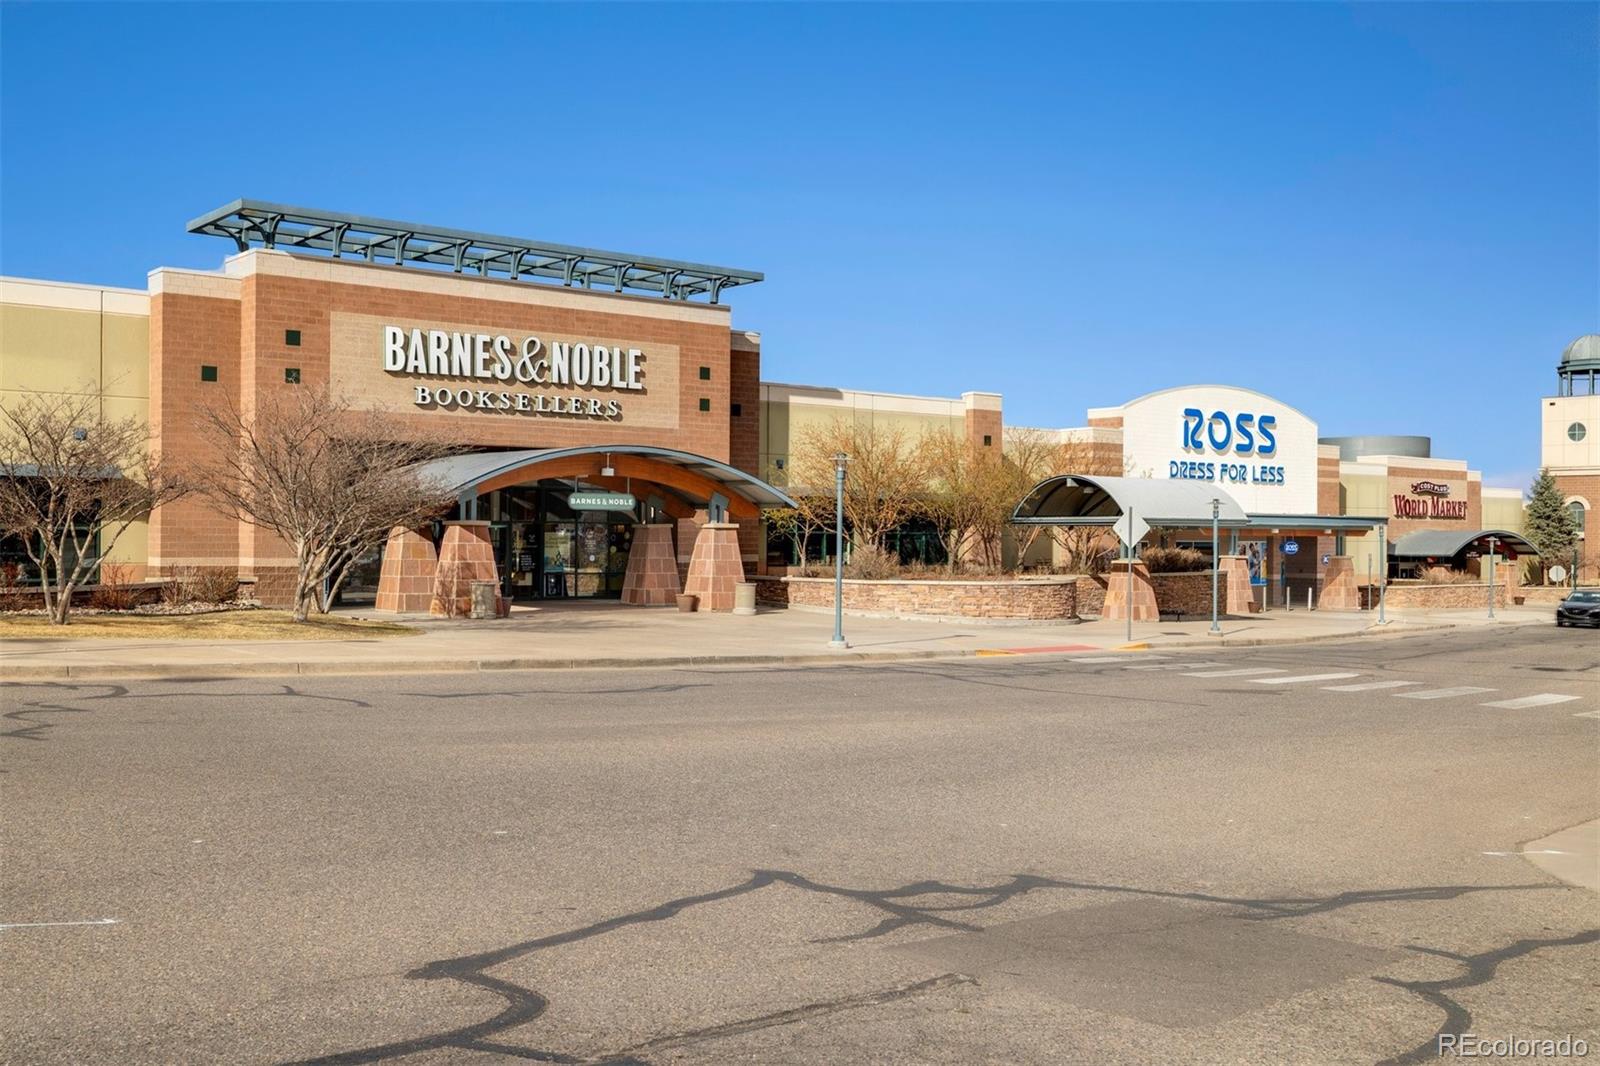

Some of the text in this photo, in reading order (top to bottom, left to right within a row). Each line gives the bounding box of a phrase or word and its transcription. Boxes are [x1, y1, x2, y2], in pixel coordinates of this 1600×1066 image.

[414, 385, 619, 417] BOOKSELLERS
[1183, 408, 1276, 454] ROSS
[1169, 460, 1285, 483] DRESS FOR LESS
[1394, 494, 1467, 518] WORLD MARKET
